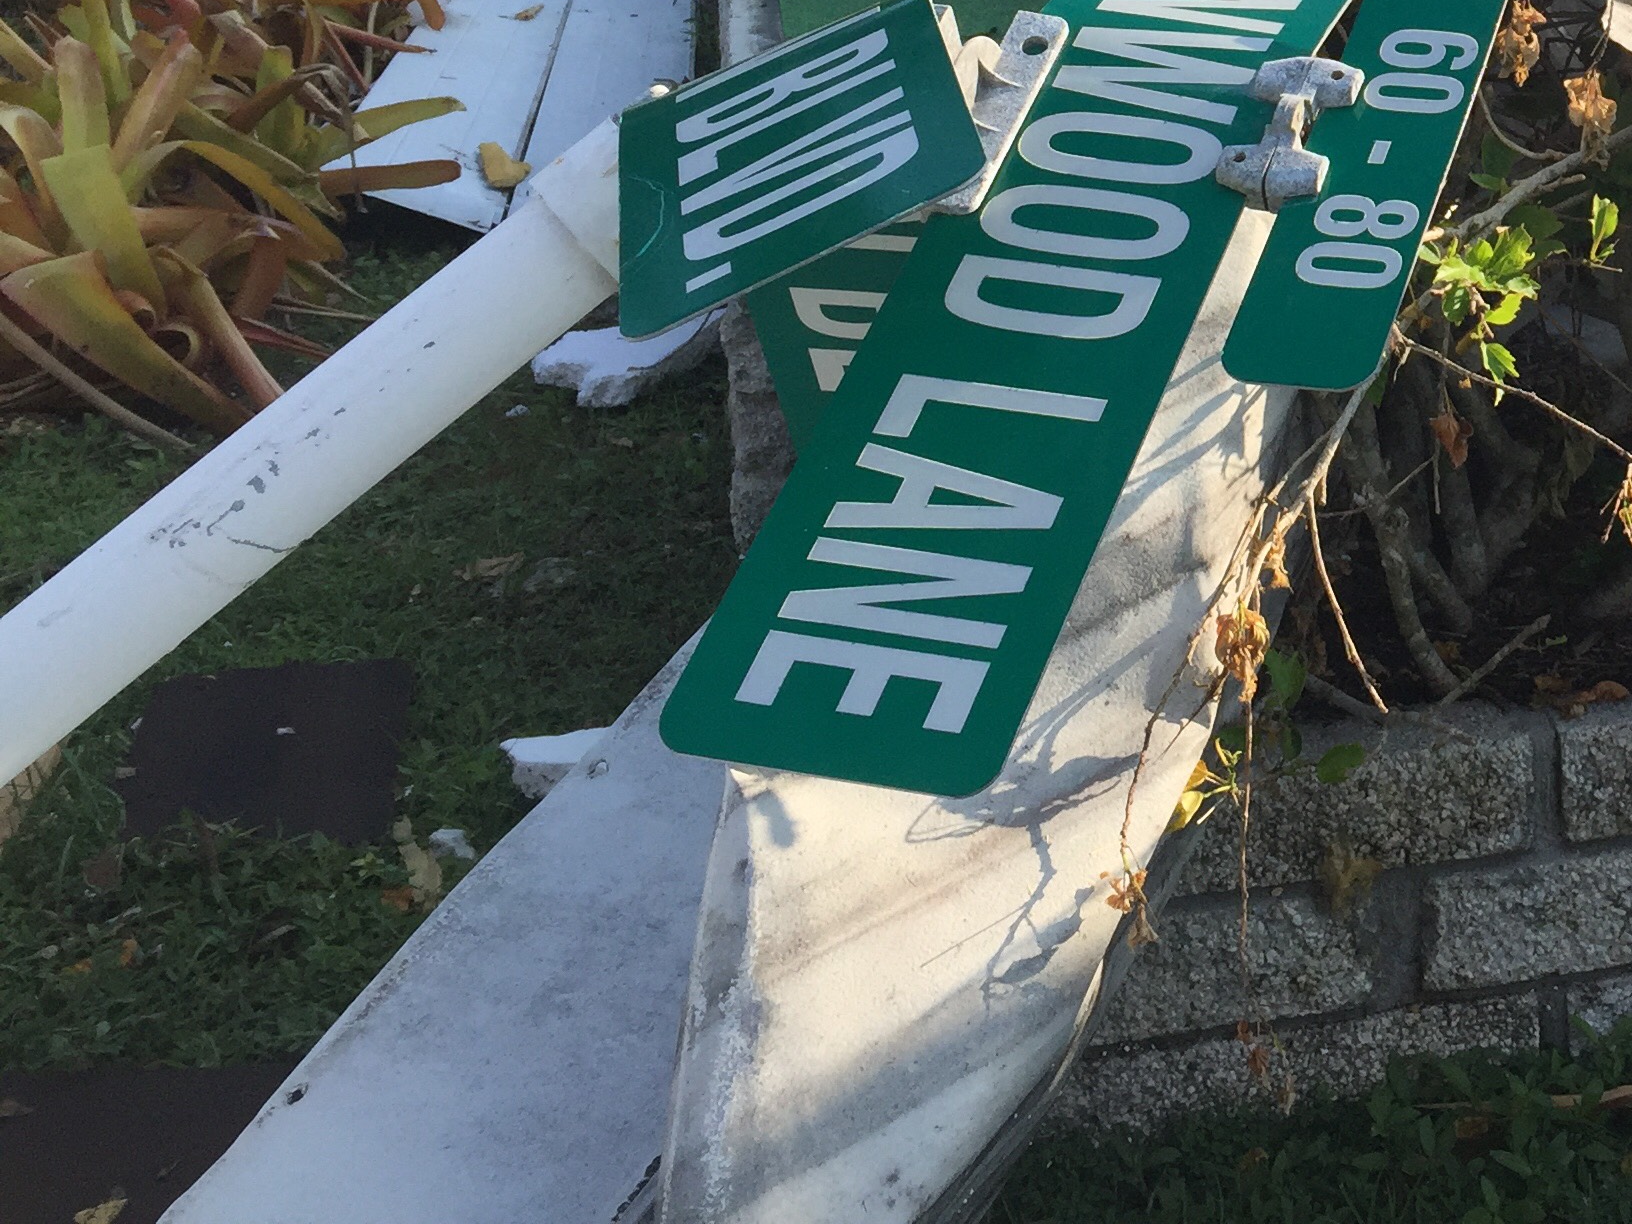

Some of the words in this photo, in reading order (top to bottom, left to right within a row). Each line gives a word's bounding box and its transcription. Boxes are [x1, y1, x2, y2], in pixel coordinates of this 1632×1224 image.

[1363, 28, 1479, 114] 60
[675, 27, 920, 294] BLVD.
[1367, 140, 1392, 164] -
[1295, 194, 1420, 289] 80
[734, 373, 1108, 734] LANE
